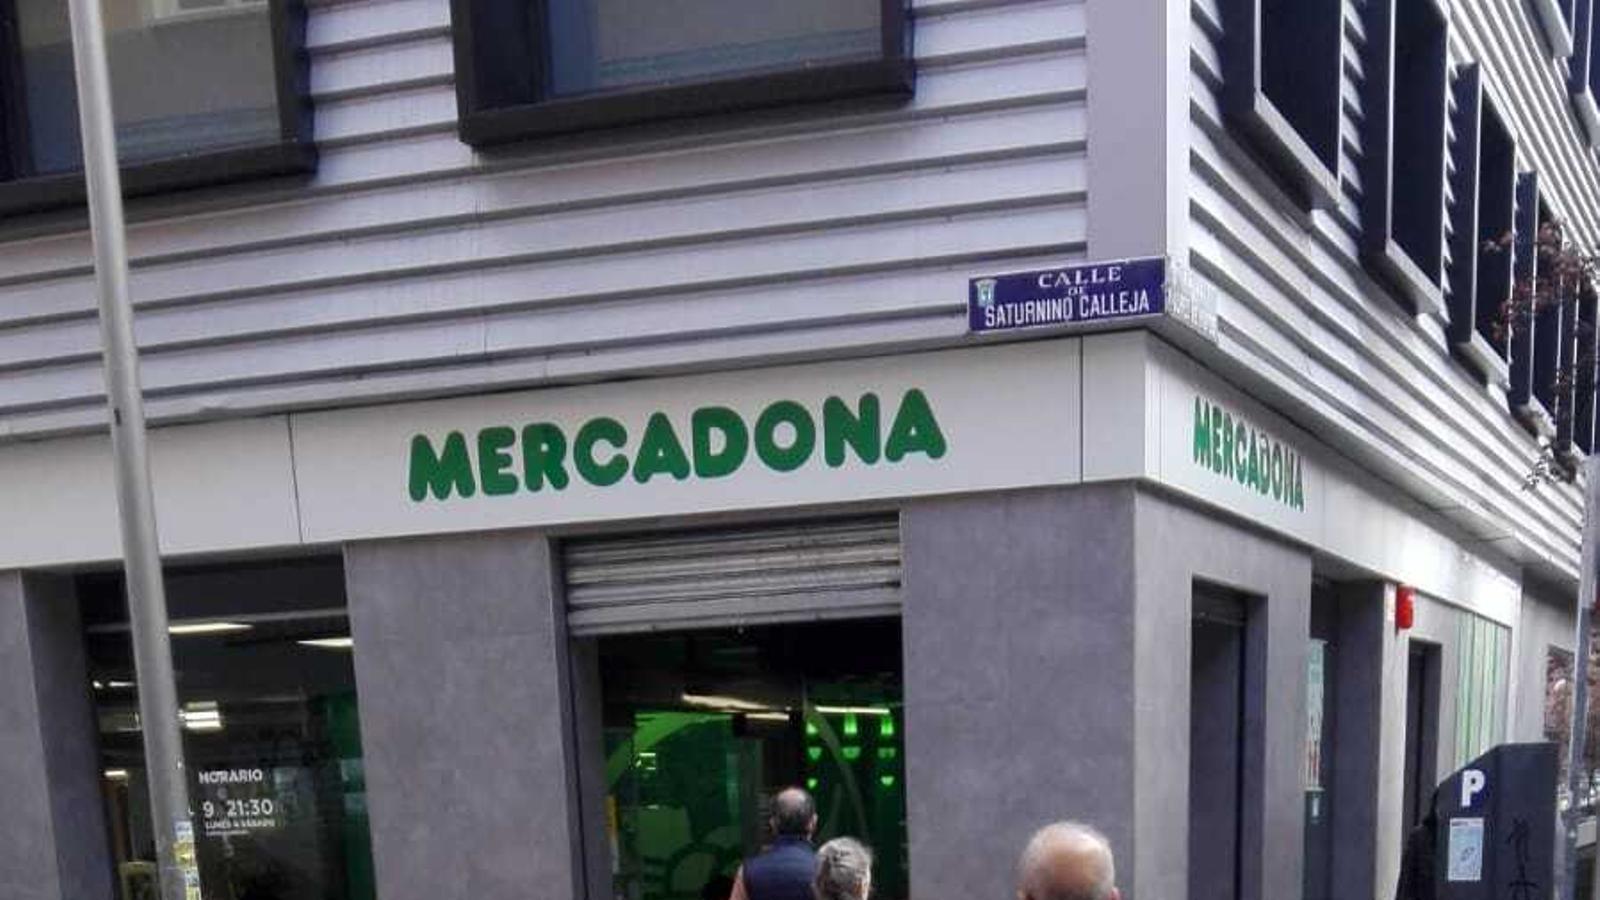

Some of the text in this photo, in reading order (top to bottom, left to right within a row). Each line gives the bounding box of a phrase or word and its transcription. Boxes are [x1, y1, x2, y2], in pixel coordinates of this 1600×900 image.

[1038, 266, 1122, 287] CALLE
[985, 290, 1150, 327] SATURNINO CALLEJA
[408, 388, 947, 502] MERCADONA
[1193, 395, 1304, 512] MERCADONA
[199, 769, 263, 784] HORARIO
[1461, 769, 1486, 807] P
[203, 798, 273, 818] 9 21:30
